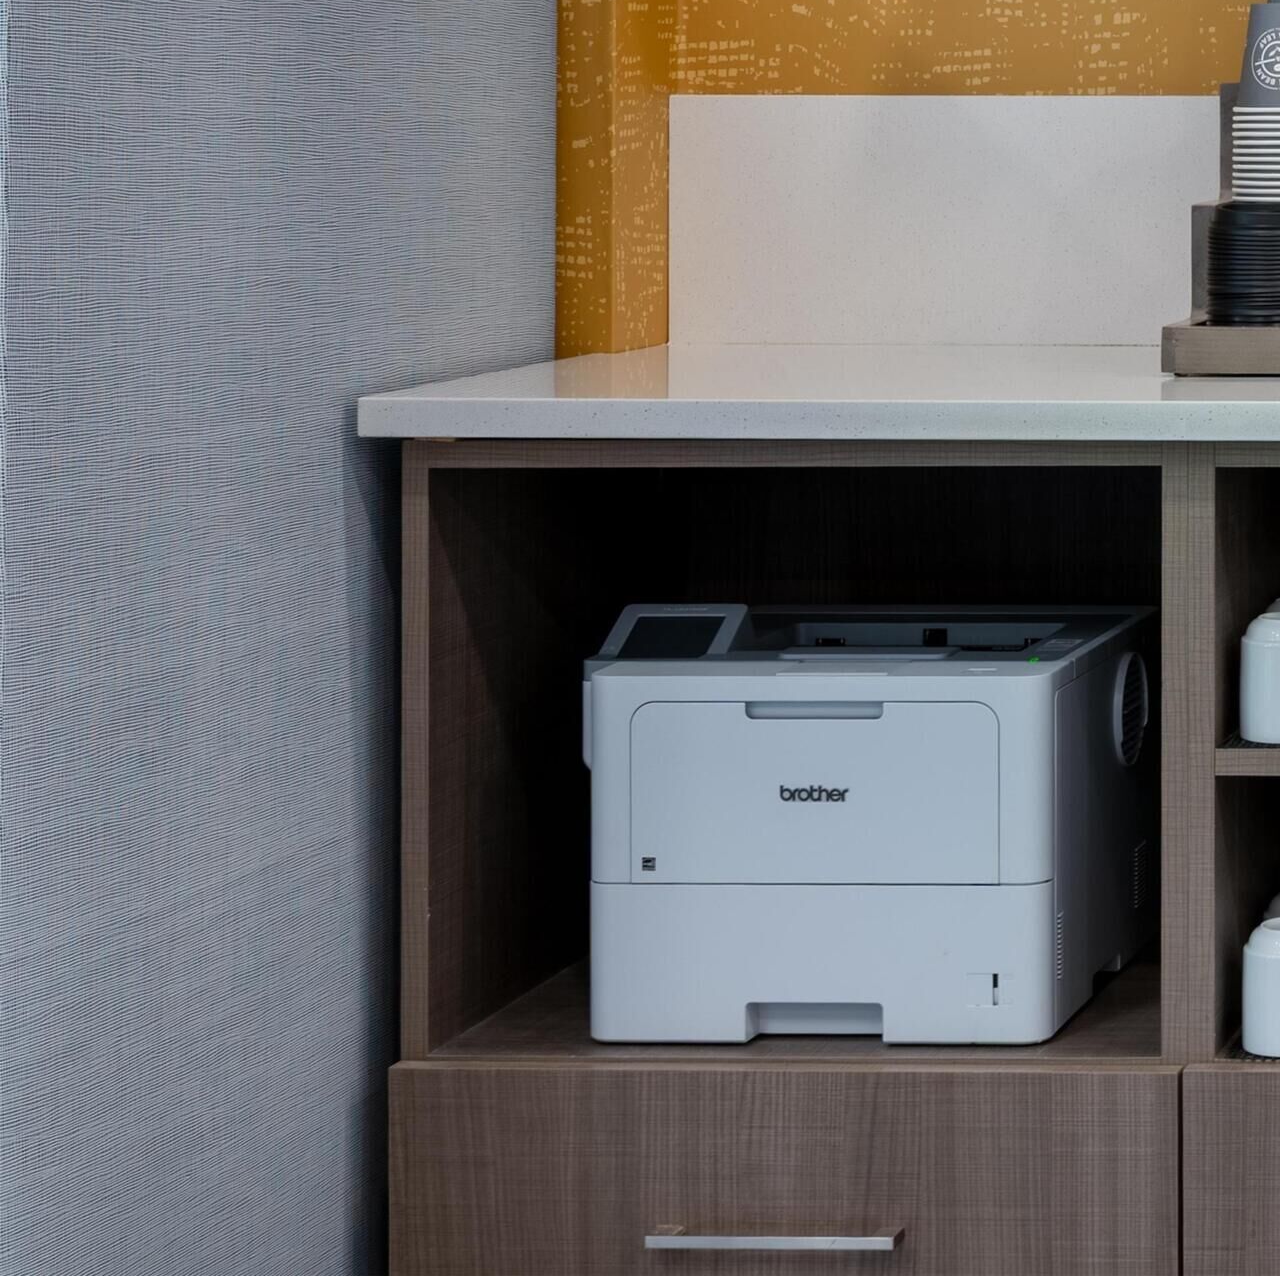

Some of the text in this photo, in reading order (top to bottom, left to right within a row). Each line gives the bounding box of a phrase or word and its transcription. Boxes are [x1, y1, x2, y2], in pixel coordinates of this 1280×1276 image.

[1259, 33, 1277, 49] LEAF
[1256, 68, 1276, 86] BEAN
[779, 784, 849, 803] brother
